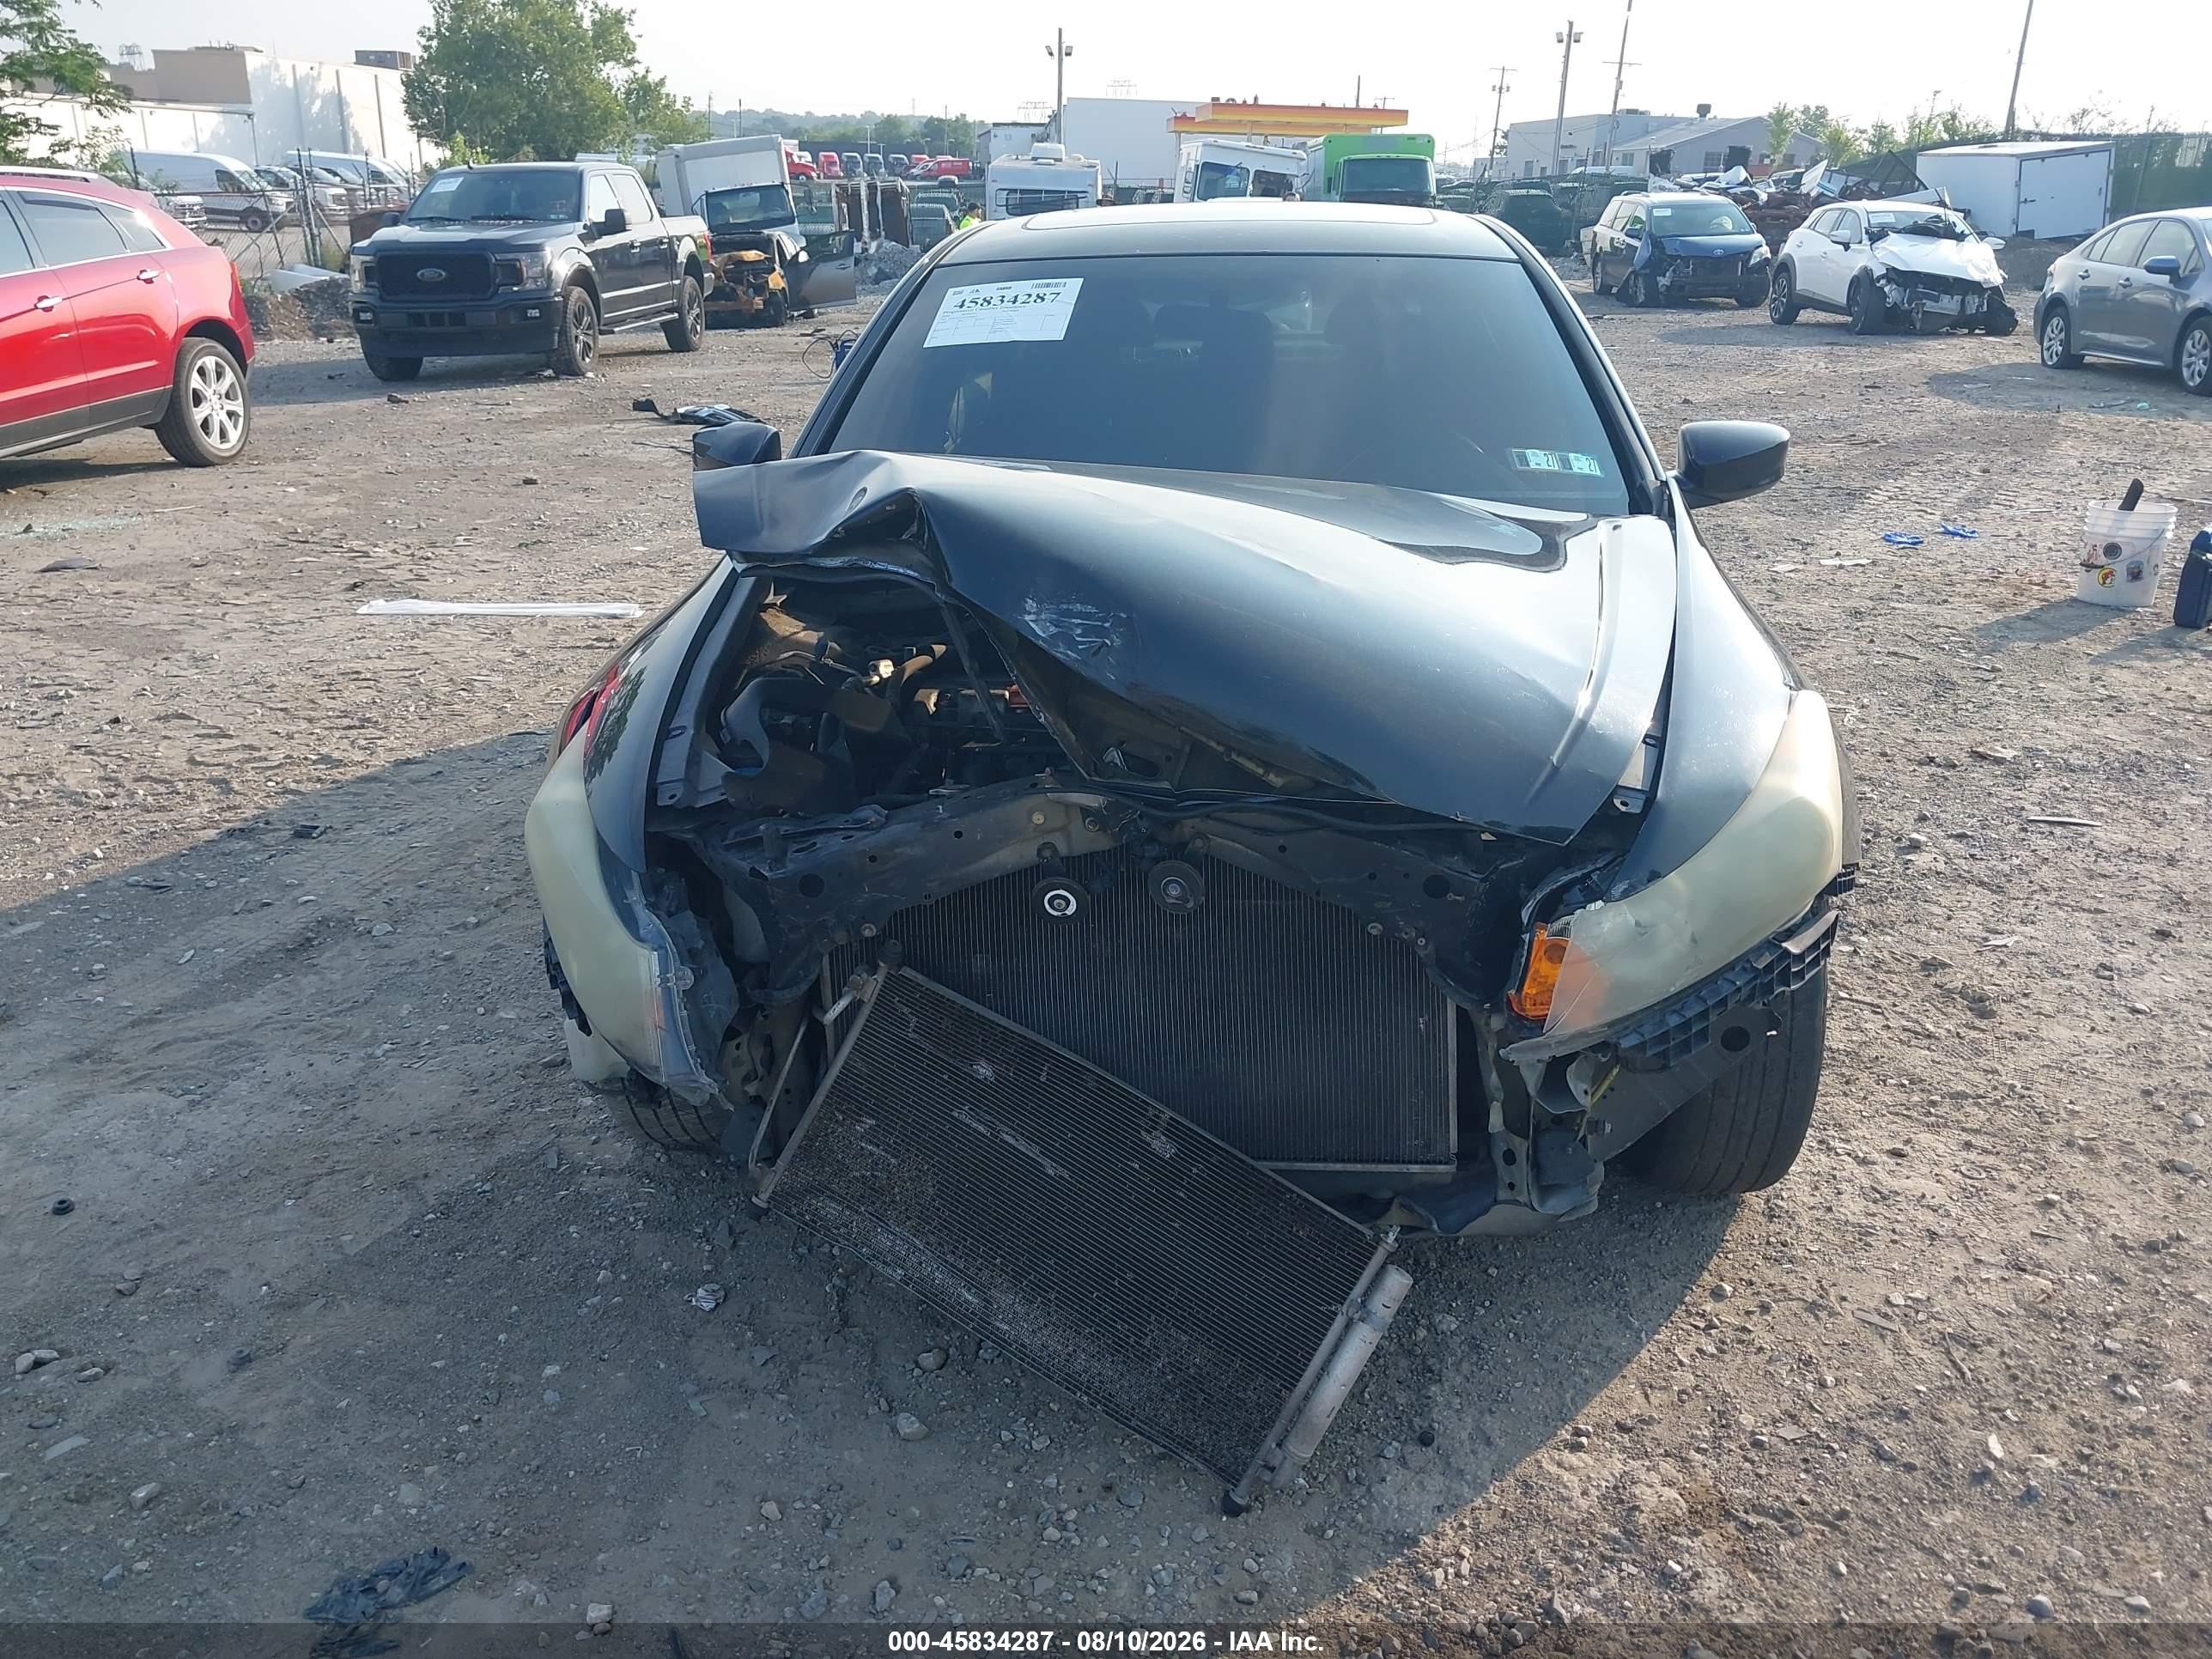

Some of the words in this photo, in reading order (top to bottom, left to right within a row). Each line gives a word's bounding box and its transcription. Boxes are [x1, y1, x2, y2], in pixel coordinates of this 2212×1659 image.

[953, 292, 1061, 309] 45834287
[1543, 453, 1556, 468] 27
[1585, 457, 1597, 473] 27
